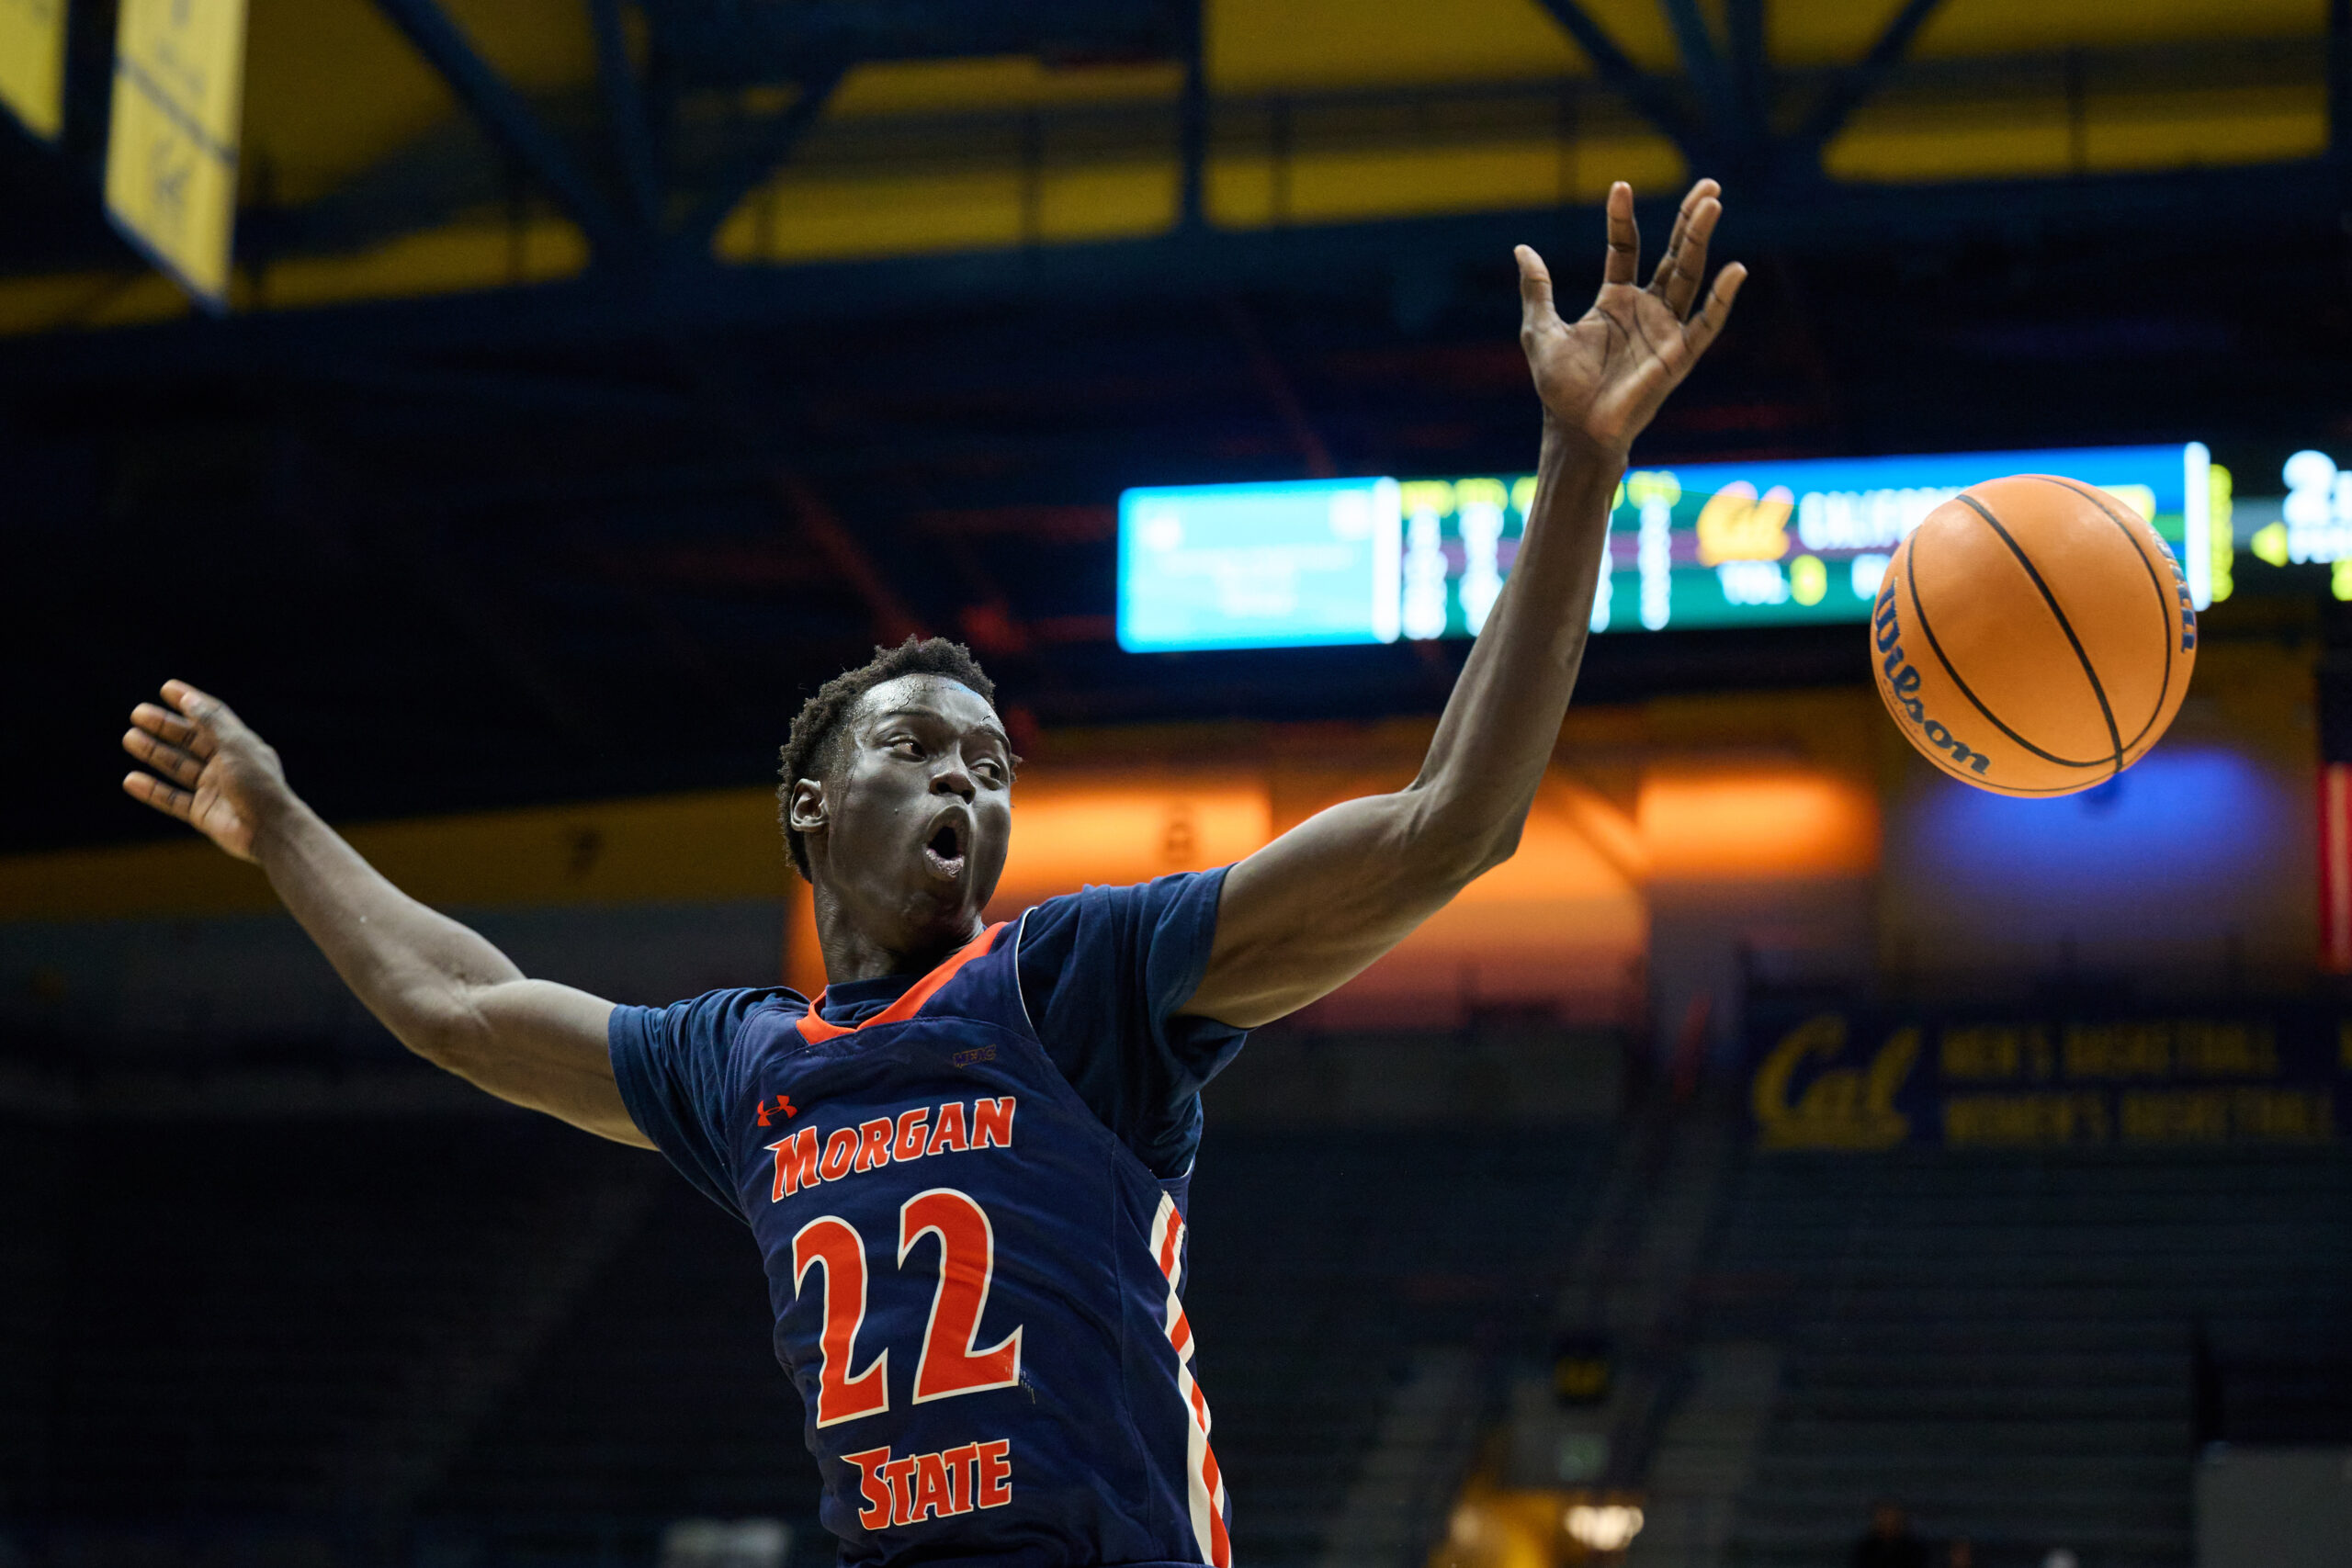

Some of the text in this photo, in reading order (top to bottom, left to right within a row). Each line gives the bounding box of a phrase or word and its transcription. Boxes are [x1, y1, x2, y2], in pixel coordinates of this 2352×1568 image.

[1875, 576, 1991, 775] Wilson
[763, 1096, 1016, 1202] MORGAN
[1752, 1013, 1921, 1151] Cal
[792, 1188, 1023, 1429] 22
[840, 1438, 1012, 1529] STATE
